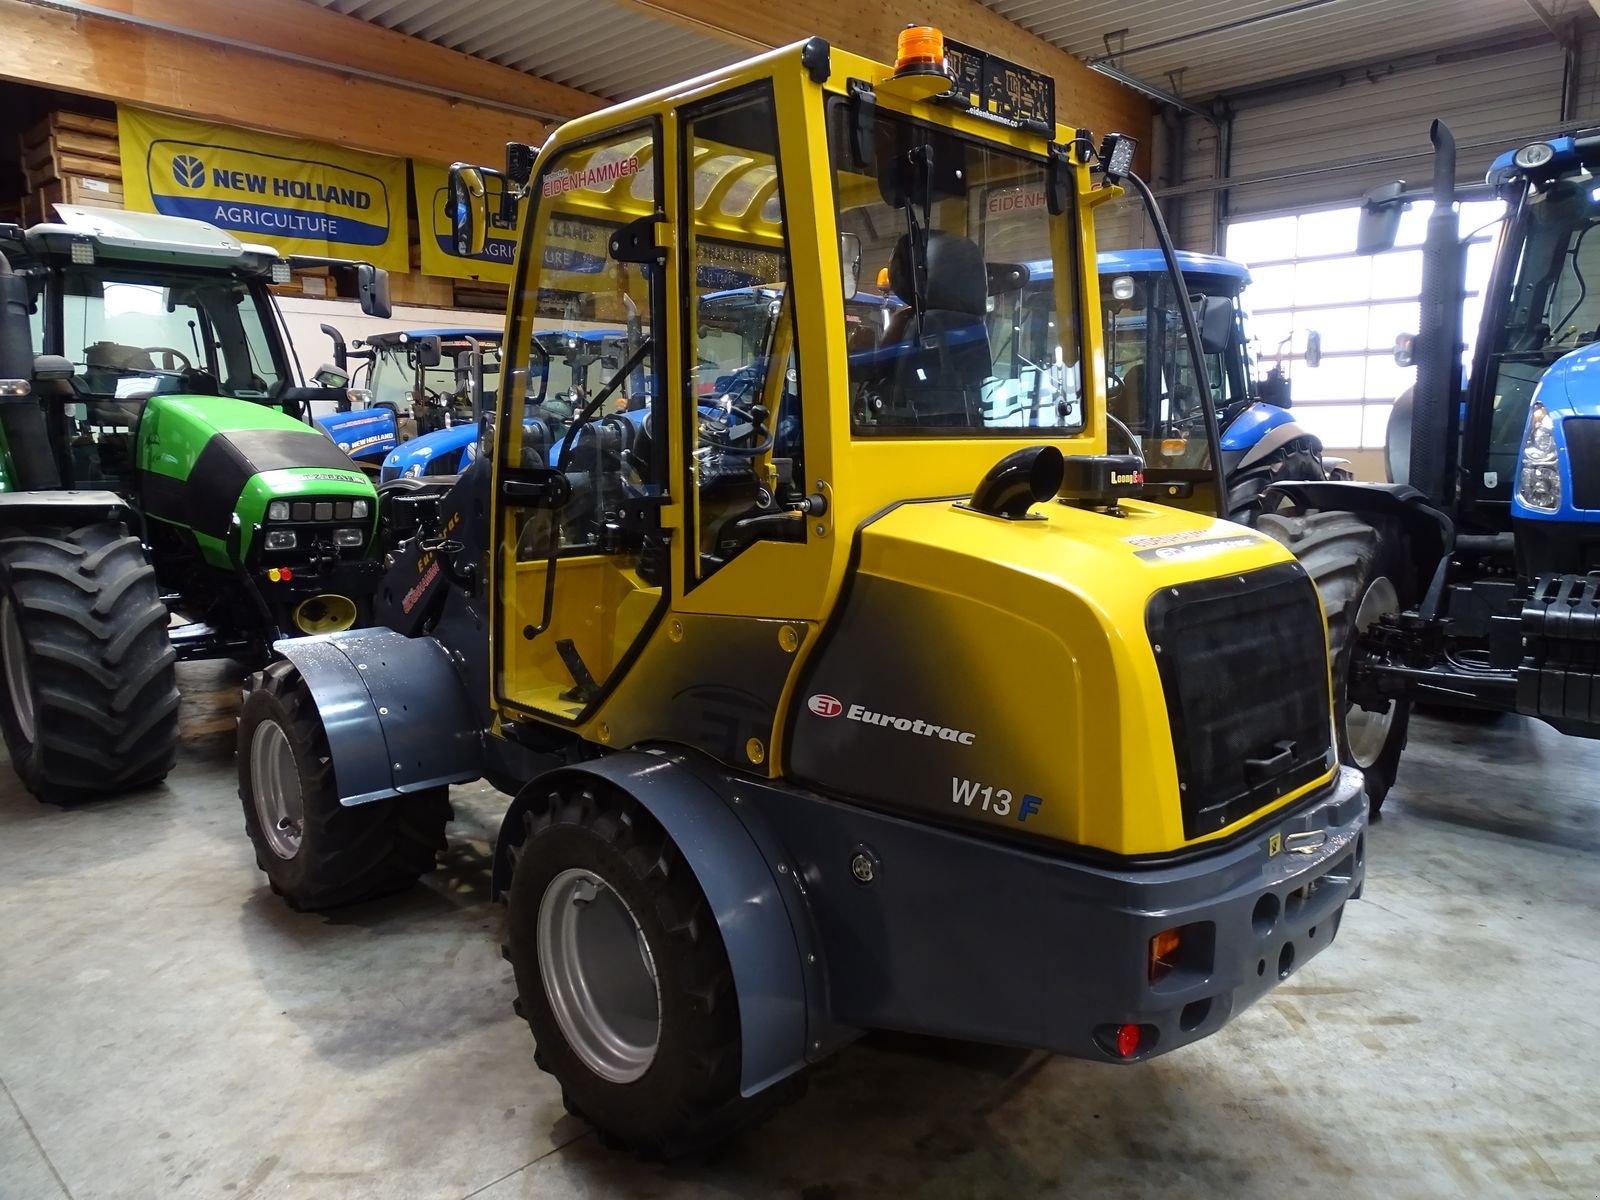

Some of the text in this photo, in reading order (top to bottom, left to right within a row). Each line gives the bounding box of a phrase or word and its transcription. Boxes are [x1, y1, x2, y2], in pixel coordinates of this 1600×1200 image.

[213, 168, 371, 210] NEW HOLLAND
[543, 156, 639, 198] EIDENHAMMER
[989, 192, 1047, 213] EIDENH
[366, 433, 394, 444] HOLLAND
[811, 695, 976, 745] ET Eurotrac
[952, 777, 1042, 821] W13 F
